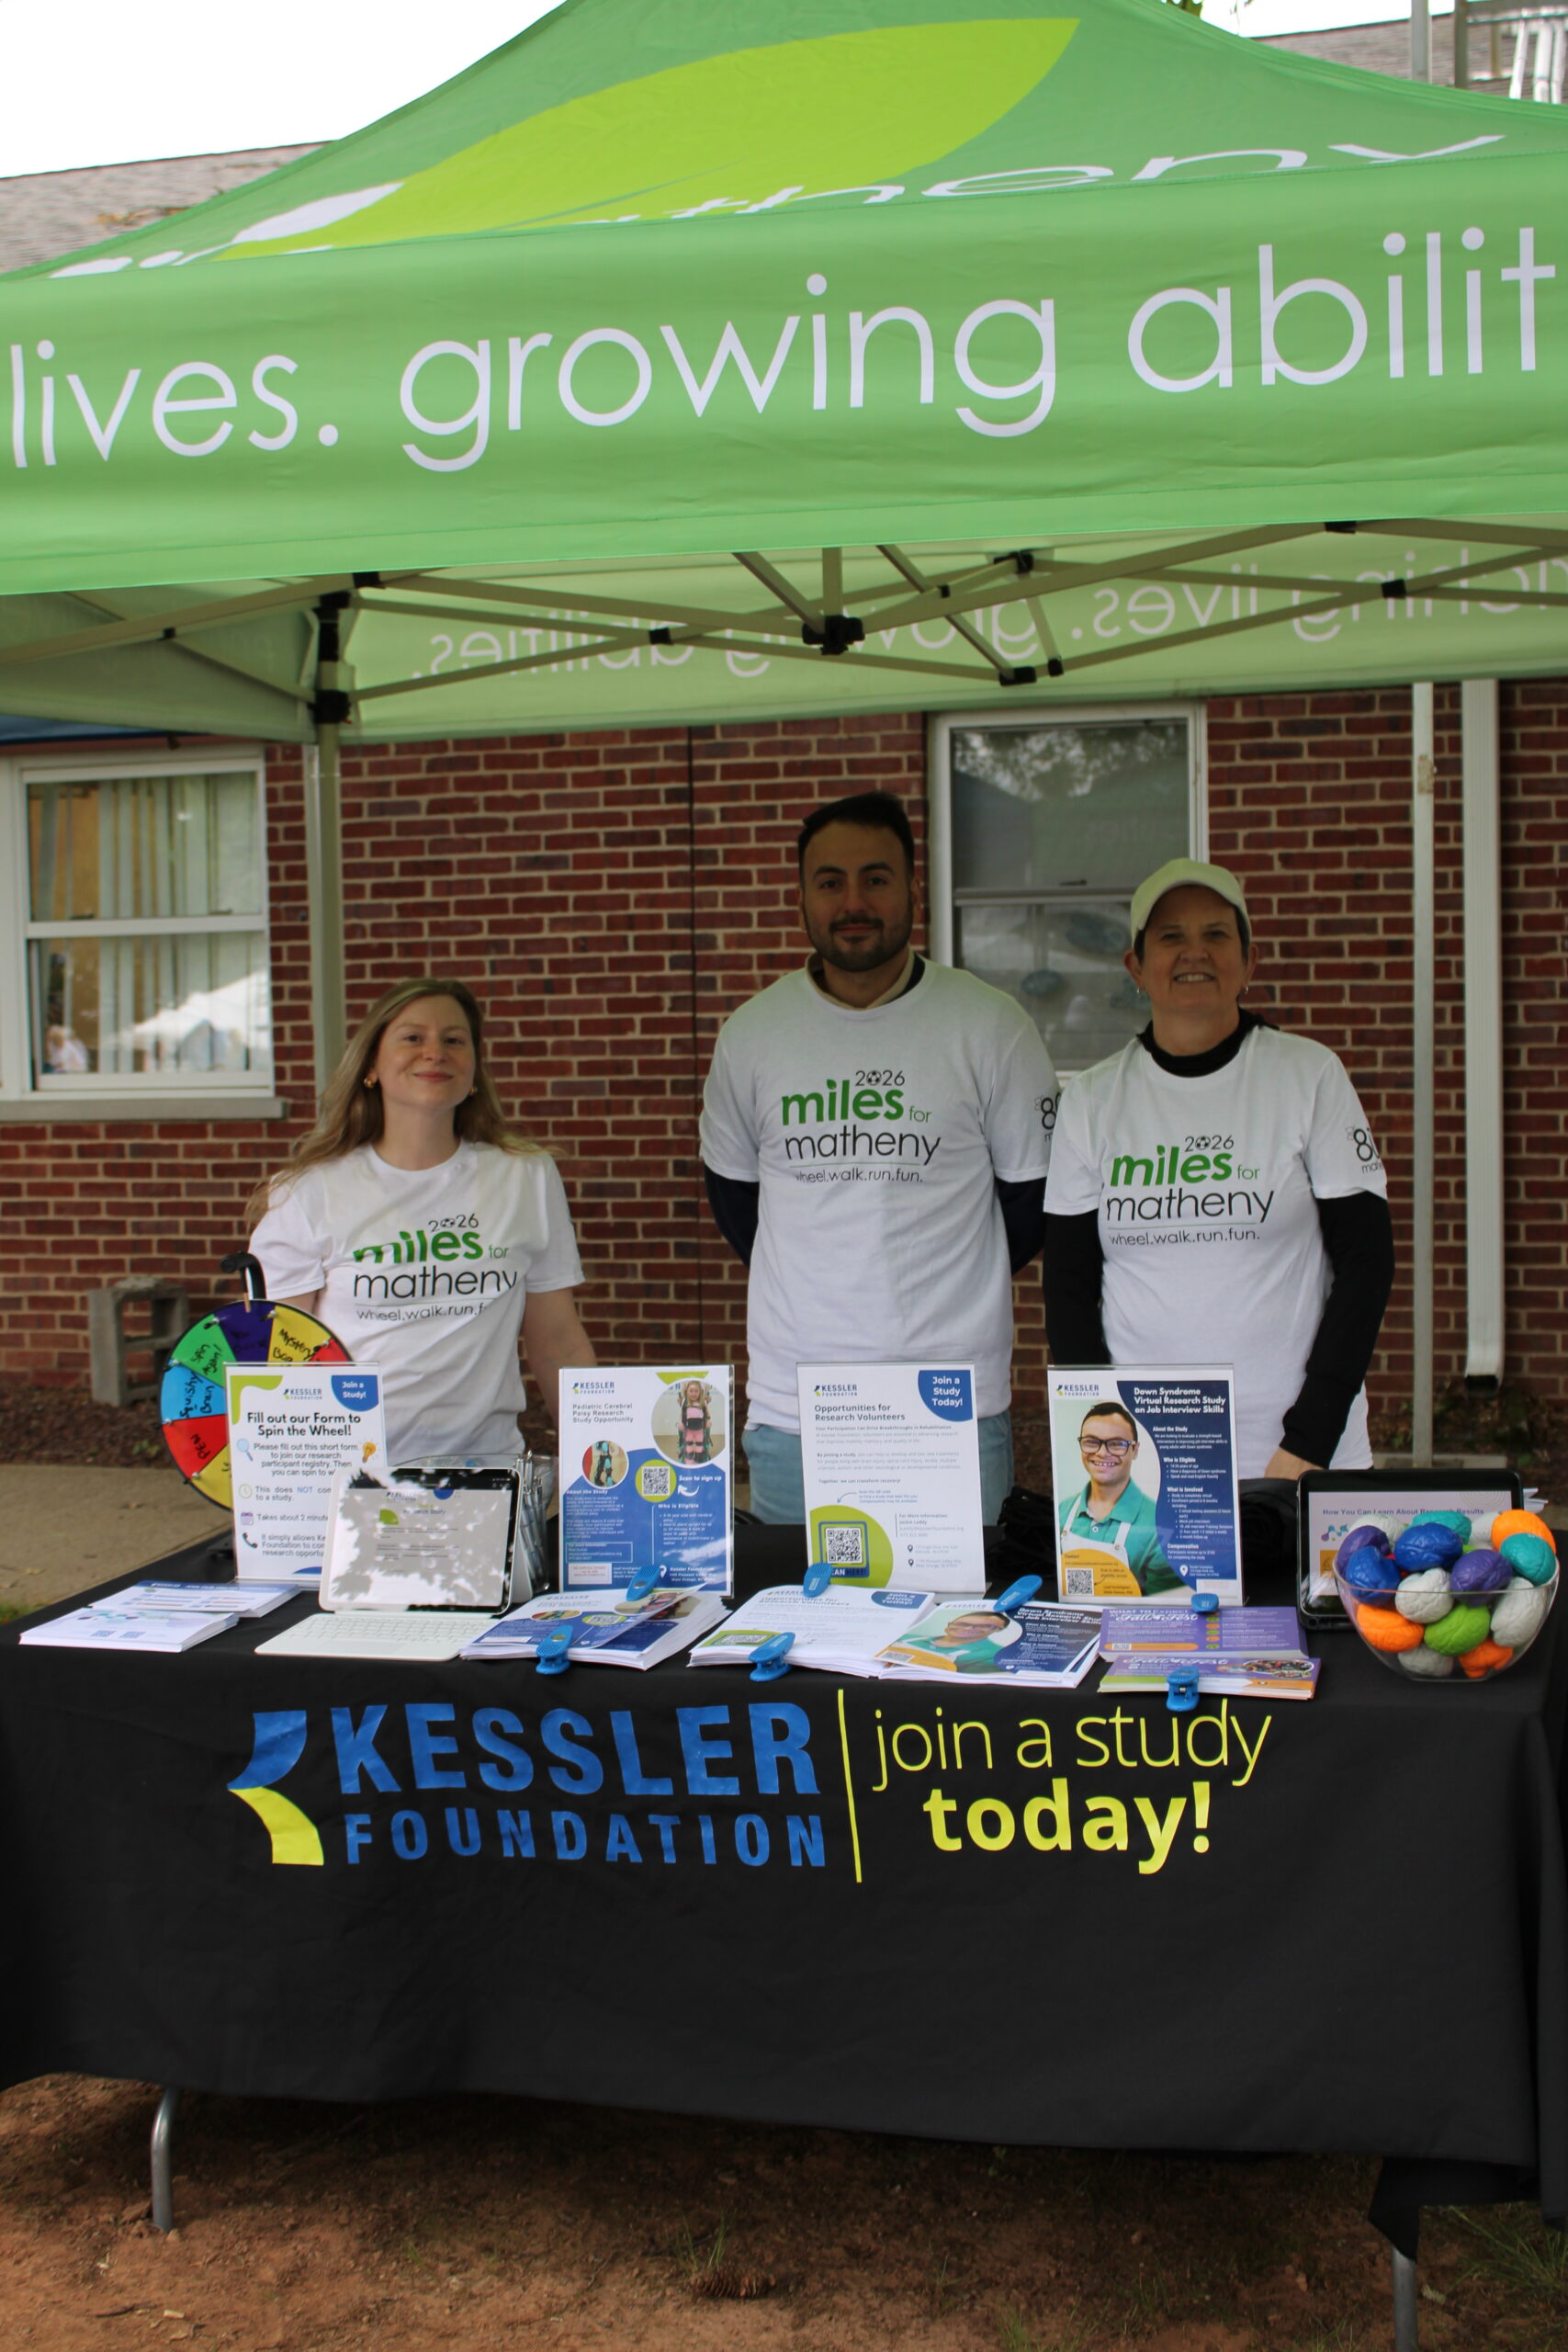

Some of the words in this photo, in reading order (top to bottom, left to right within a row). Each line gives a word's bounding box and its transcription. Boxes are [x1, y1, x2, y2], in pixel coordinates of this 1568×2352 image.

[11, 339, 339, 469] lives.
[399, 273, 1056, 473] growing
[1127, 226, 1555, 392] abilit
[782, 1079, 904, 1125] miles
[909, 1106, 932, 1123] for
[785, 1124, 941, 1166] matheny
[1110, 1145, 1233, 1187] miles
[1237, 1164, 1260, 1181] for
[1107, 1188, 1274, 1223] matheny
[353, 1229, 484, 1264] miles
[489, 1246, 510, 1260] for
[354, 1264, 517, 1298] matheny
[932, 1376, 952, 1385] Join
[933, 1387, 961, 1397] Study
[1134, 1387, 1158, 1396] Down
[1159, 1387, 1201, 1397] Syndrome
[931, 1398, 963, 1408] Today!
[1202, 1396, 1226, 1406] Study
[815, 1404, 875, 1416] Opportunities
[878, 1403, 891, 1412] for
[1146, 1406, 1162, 1414] Job
[247, 1412, 264, 1423] Fill
[267, 1414, 287, 1423] out
[314, 1412, 345, 1423] Form
[349, 1413, 362, 1423] to
[858, 1413, 906, 1421] Volunteers
[258, 1425, 284, 1439] Spin
[288, 1425, 306, 1435] the
[310, 1425, 352, 1436] Wheel!
[305, 1442, 317, 1451] this
[318, 1442, 338, 1451] short
[280, 1452, 293, 1461] join
[262, 1460, 300, 1468] participant
[272, 1469, 285, 1477] you
[301, 1468, 316, 1477] spin
[701, 1475, 714, 1483] sign
[255, 1485, 270, 1493] This
[274, 1485, 293, 1493] does
[331, 1702, 820, 1795] KESSLER
[872, 1706, 993, 1792] join
[1016, 1718, 1053, 1769] a
[1076, 1698, 1271, 1787] study
[922, 1777, 1211, 1874] today!
[344, 1807, 825, 1867] FOUNDATION
